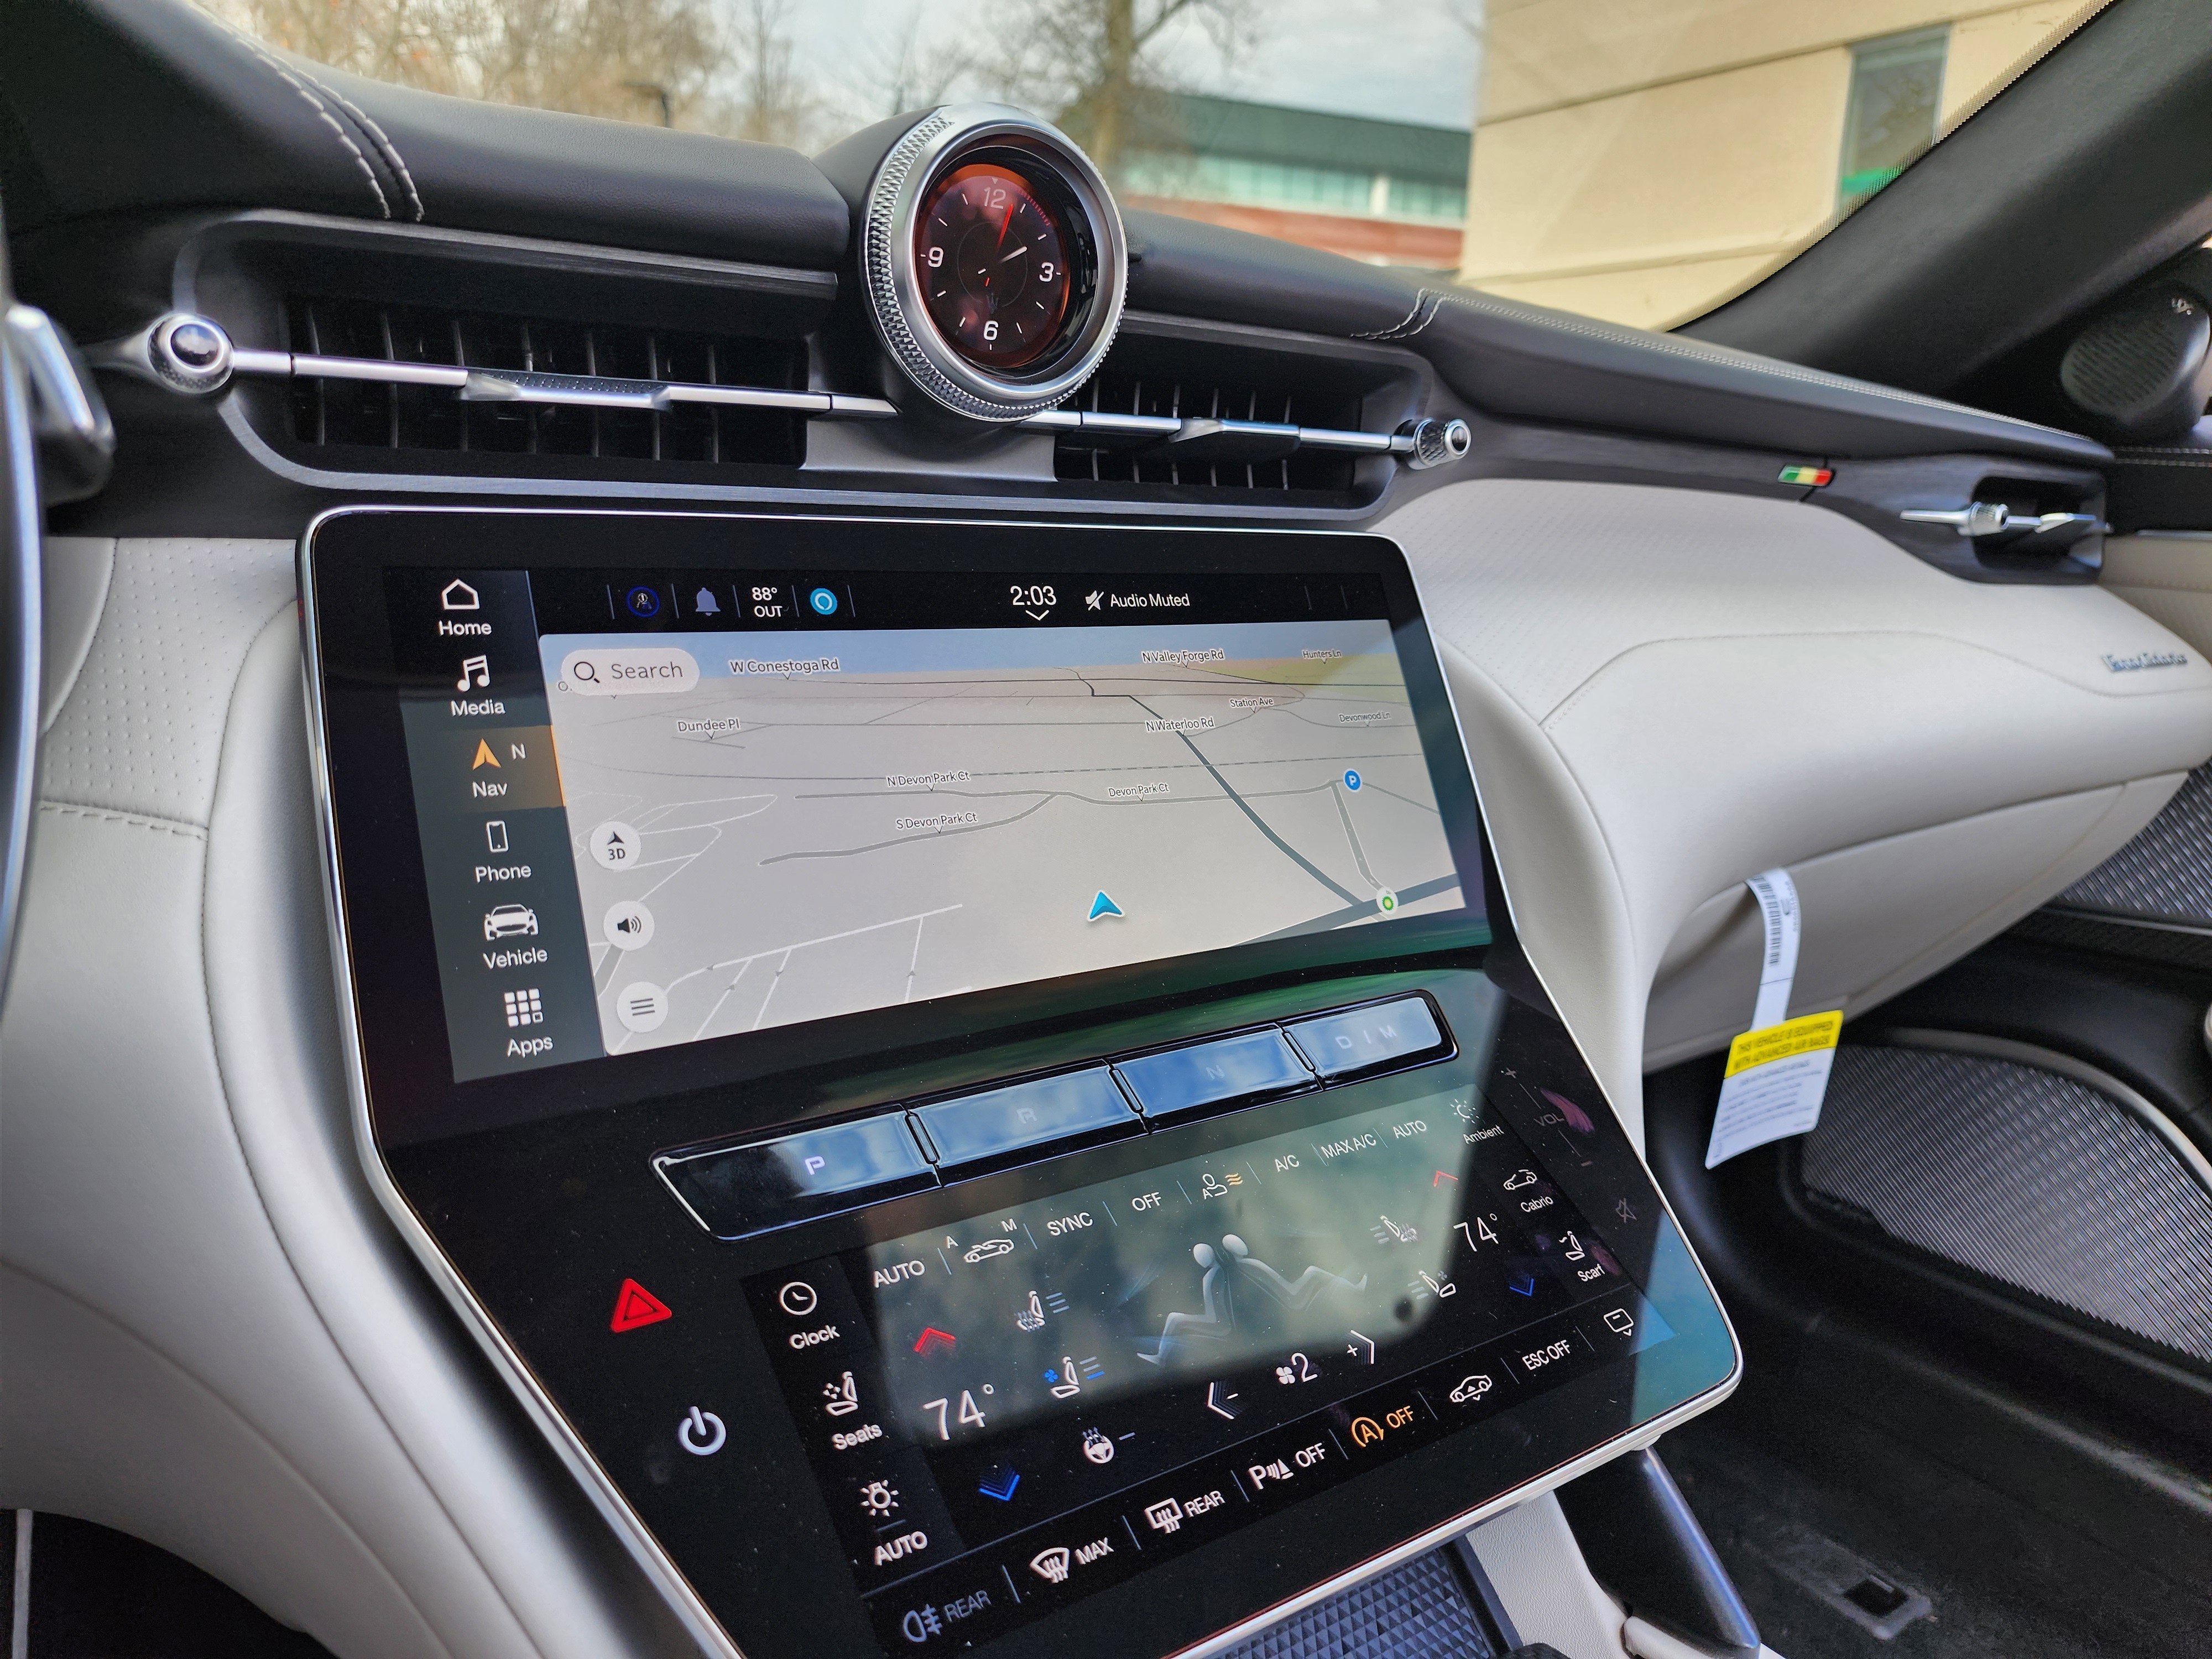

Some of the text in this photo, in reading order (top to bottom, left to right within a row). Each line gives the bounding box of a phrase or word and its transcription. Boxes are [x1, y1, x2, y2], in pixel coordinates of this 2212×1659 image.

[983, 187, 1006, 209] 12
[928, 247, 944, 267] 9
[1039, 262, 1054, 282] 3
[984, 321, 999, 341] 6
[752, 587, 778, 601] 88°
[1010, 585, 1057, 606] 2:03
[1110, 593, 1190, 607] Audio Muted
[754, 606, 783, 618] OUT
[439, 620, 492, 635] Home
[1142, 649, 1224, 664] N Valley Forge Rd
[1302, 649, 1342, 659] Hunters Ln
[611, 662, 684, 679] Search
[731, 659, 839, 674] W Conestoga Rd
[451, 699, 505, 716] Media
[1230, 697, 1273, 708] Station Ave
[677, 718, 740, 732] Dundee Pl
[1146, 718, 1214, 732] N Waterloo Rd
[1339, 711, 1390, 722] Devonwood Ln
[512, 744, 526, 759] N
[888, 771, 970, 786] N Devon Park Ct
[1349, 775, 1357, 786] P
[472, 781, 508, 798] Nav
[1109, 783, 1169, 797] Devon Park Ct
[896, 812, 978, 829] S Devon Park Ct
[608, 848, 626, 860] 3D
[475, 864, 531, 883] Phone
[483, 947, 548, 969] Vehicle
[507, 1036, 554, 1058] Apps
[1205, 1063, 1225, 1081] N
[1017, 1107, 1038, 1124] R
[1534, 1113, 1566, 1126] VOL
[1392, 1120, 1427, 1139] AUTO
[1463, 1124, 1504, 1144] Ambient
[1321, 1134, 1377, 1159] MAX A/C
[805, 1155, 826, 1175] P
[1275, 1155, 1300, 1172] A/C
[1131, 1191, 1163, 1211] OFF
[1520, 1195, 1554, 1213] Cabrio
[1001, 1218, 1018, 1233] M
[1047, 1212, 1094, 1237] SYNC
[945, 1236, 958, 1249] A
[873, 1260, 926, 1288] AUTO
[1577, 1263, 1605, 1282] Scarf
[789, 1324, 841, 1349] Clock
[1522, 1339, 1571, 1371] ESC OFF
[1291, 1352, 1318, 1383] 2
[1386, 1405, 1414, 1429] OFF
[832, 1423, 883, 1450] Seats
[1294, 1442, 1326, 1469] OFF
[1183, 1490, 1226, 1519] REAR
[874, 1530, 928, 1567] AUTO
[1073, 1536, 1114, 1565] MAX
[943, 1589, 993, 1623] REAR
